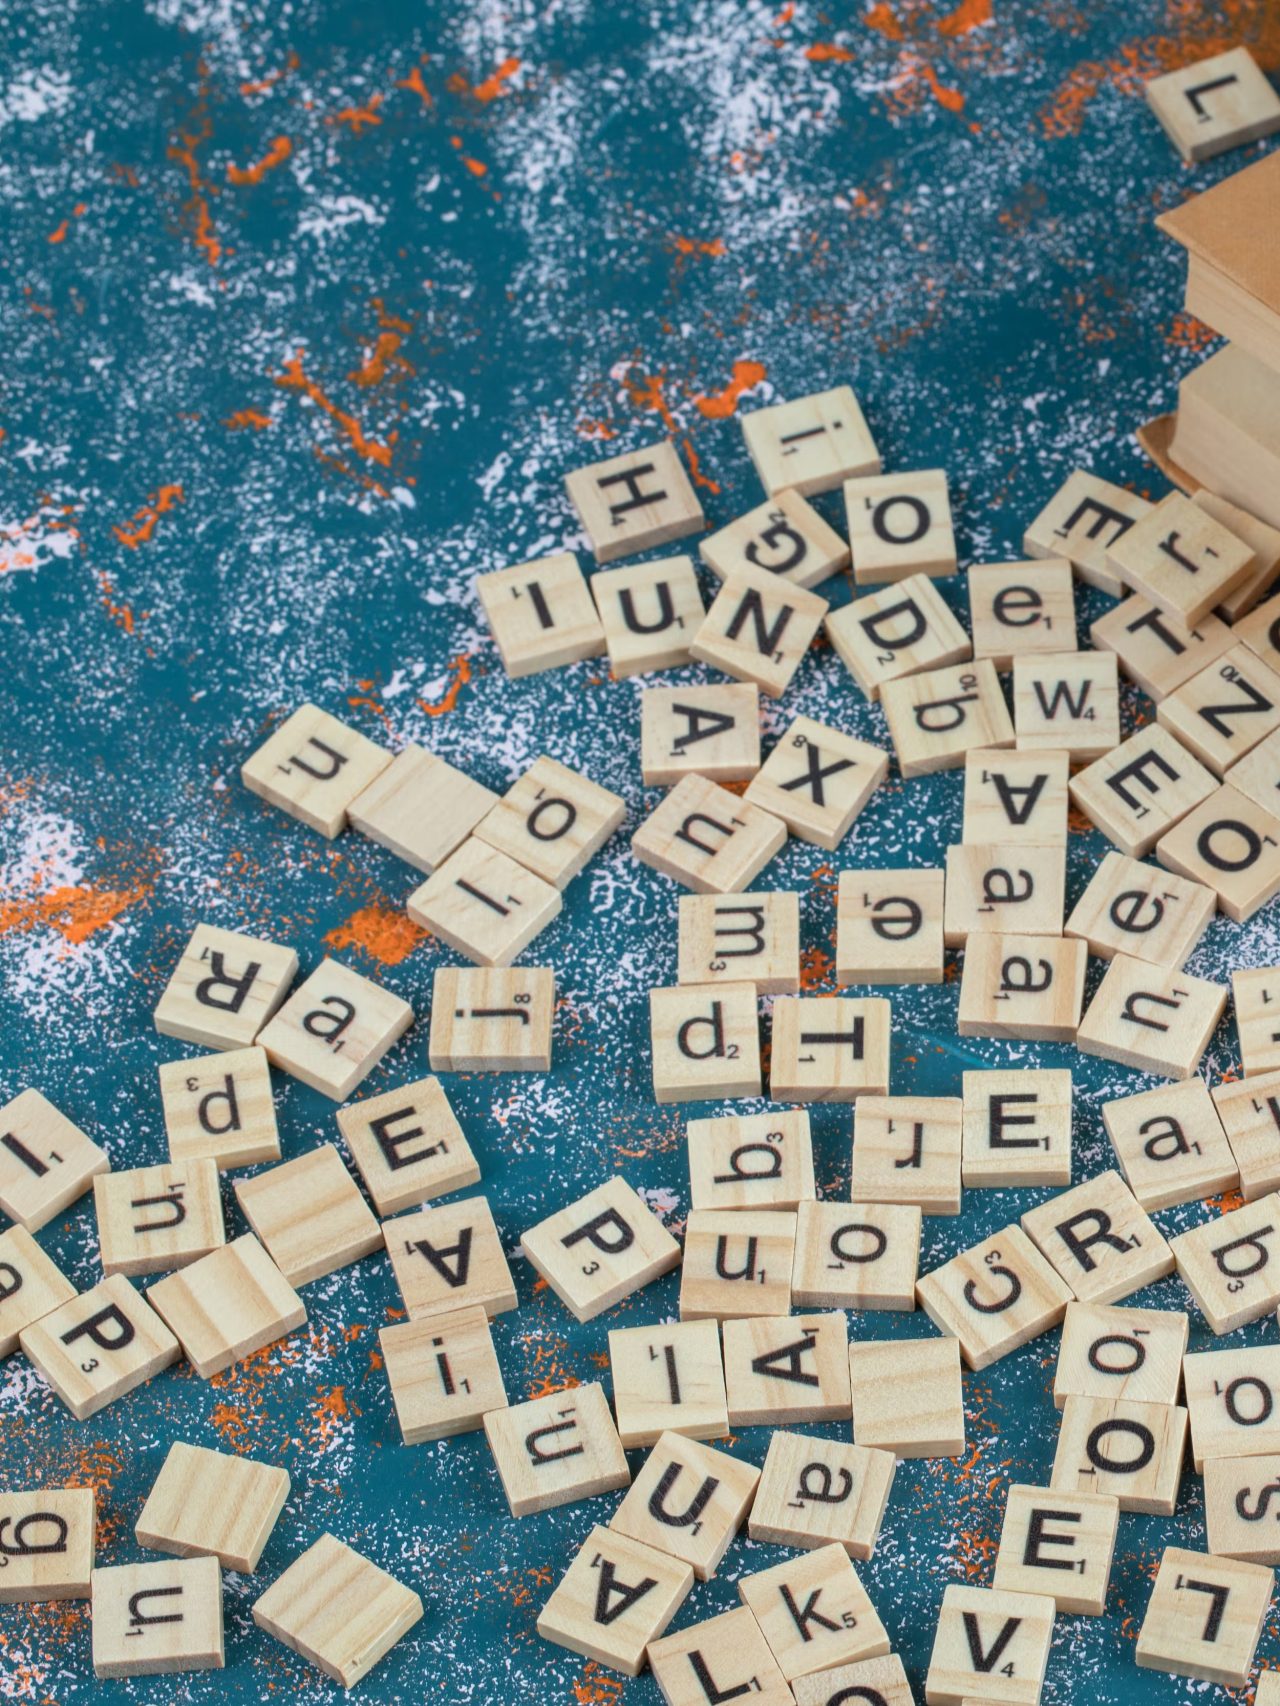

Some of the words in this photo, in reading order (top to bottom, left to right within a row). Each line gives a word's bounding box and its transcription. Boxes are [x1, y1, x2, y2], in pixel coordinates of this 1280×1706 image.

[1184, 73, 1238, 116] L
[780, 420, 843, 445] i
[597, 463, 667, 517] H
[745, 520, 807, 575] G
[1062, 496, 1137, 549] E
[1158, 531, 1199, 575] r
[725, 588, 794, 657] N
[859, 597, 928, 651] D
[992, 585, 1043, 628] e
[1125, 607, 1186, 656] T
[672, 703, 735, 749] A
[991, 773, 1049, 825] A
[1105, 749, 1181, 811] E
[982, 868, 1034, 904] a
[1109, 890, 1164, 934] e
[715, 906, 765, 959] m
[871, 896, 923, 941] e
[195, 951, 260, 1013] R
[1000, 956, 1053, 993] a
[302, 996, 356, 1045] a
[455, 1008, 531, 1026] j
[800, 1016, 865, 1060] T
[369, 1106, 437, 1171] E
[989, 1093, 1040, 1149] E
[1139, 1115, 1190, 1162] a
[415, 1227, 473, 1288] A
[1055, 1208, 1132, 1272] R
[431, 1337, 456, 1396] i
[751, 1336, 819, 1387] A
[795, 1462, 853, 1504] a
[1022, 1508, 1081, 1571] E
[594, 1559, 657, 1626] A
[1186, 1580, 1230, 1643] L
[687, 1650, 752, 1706] L
